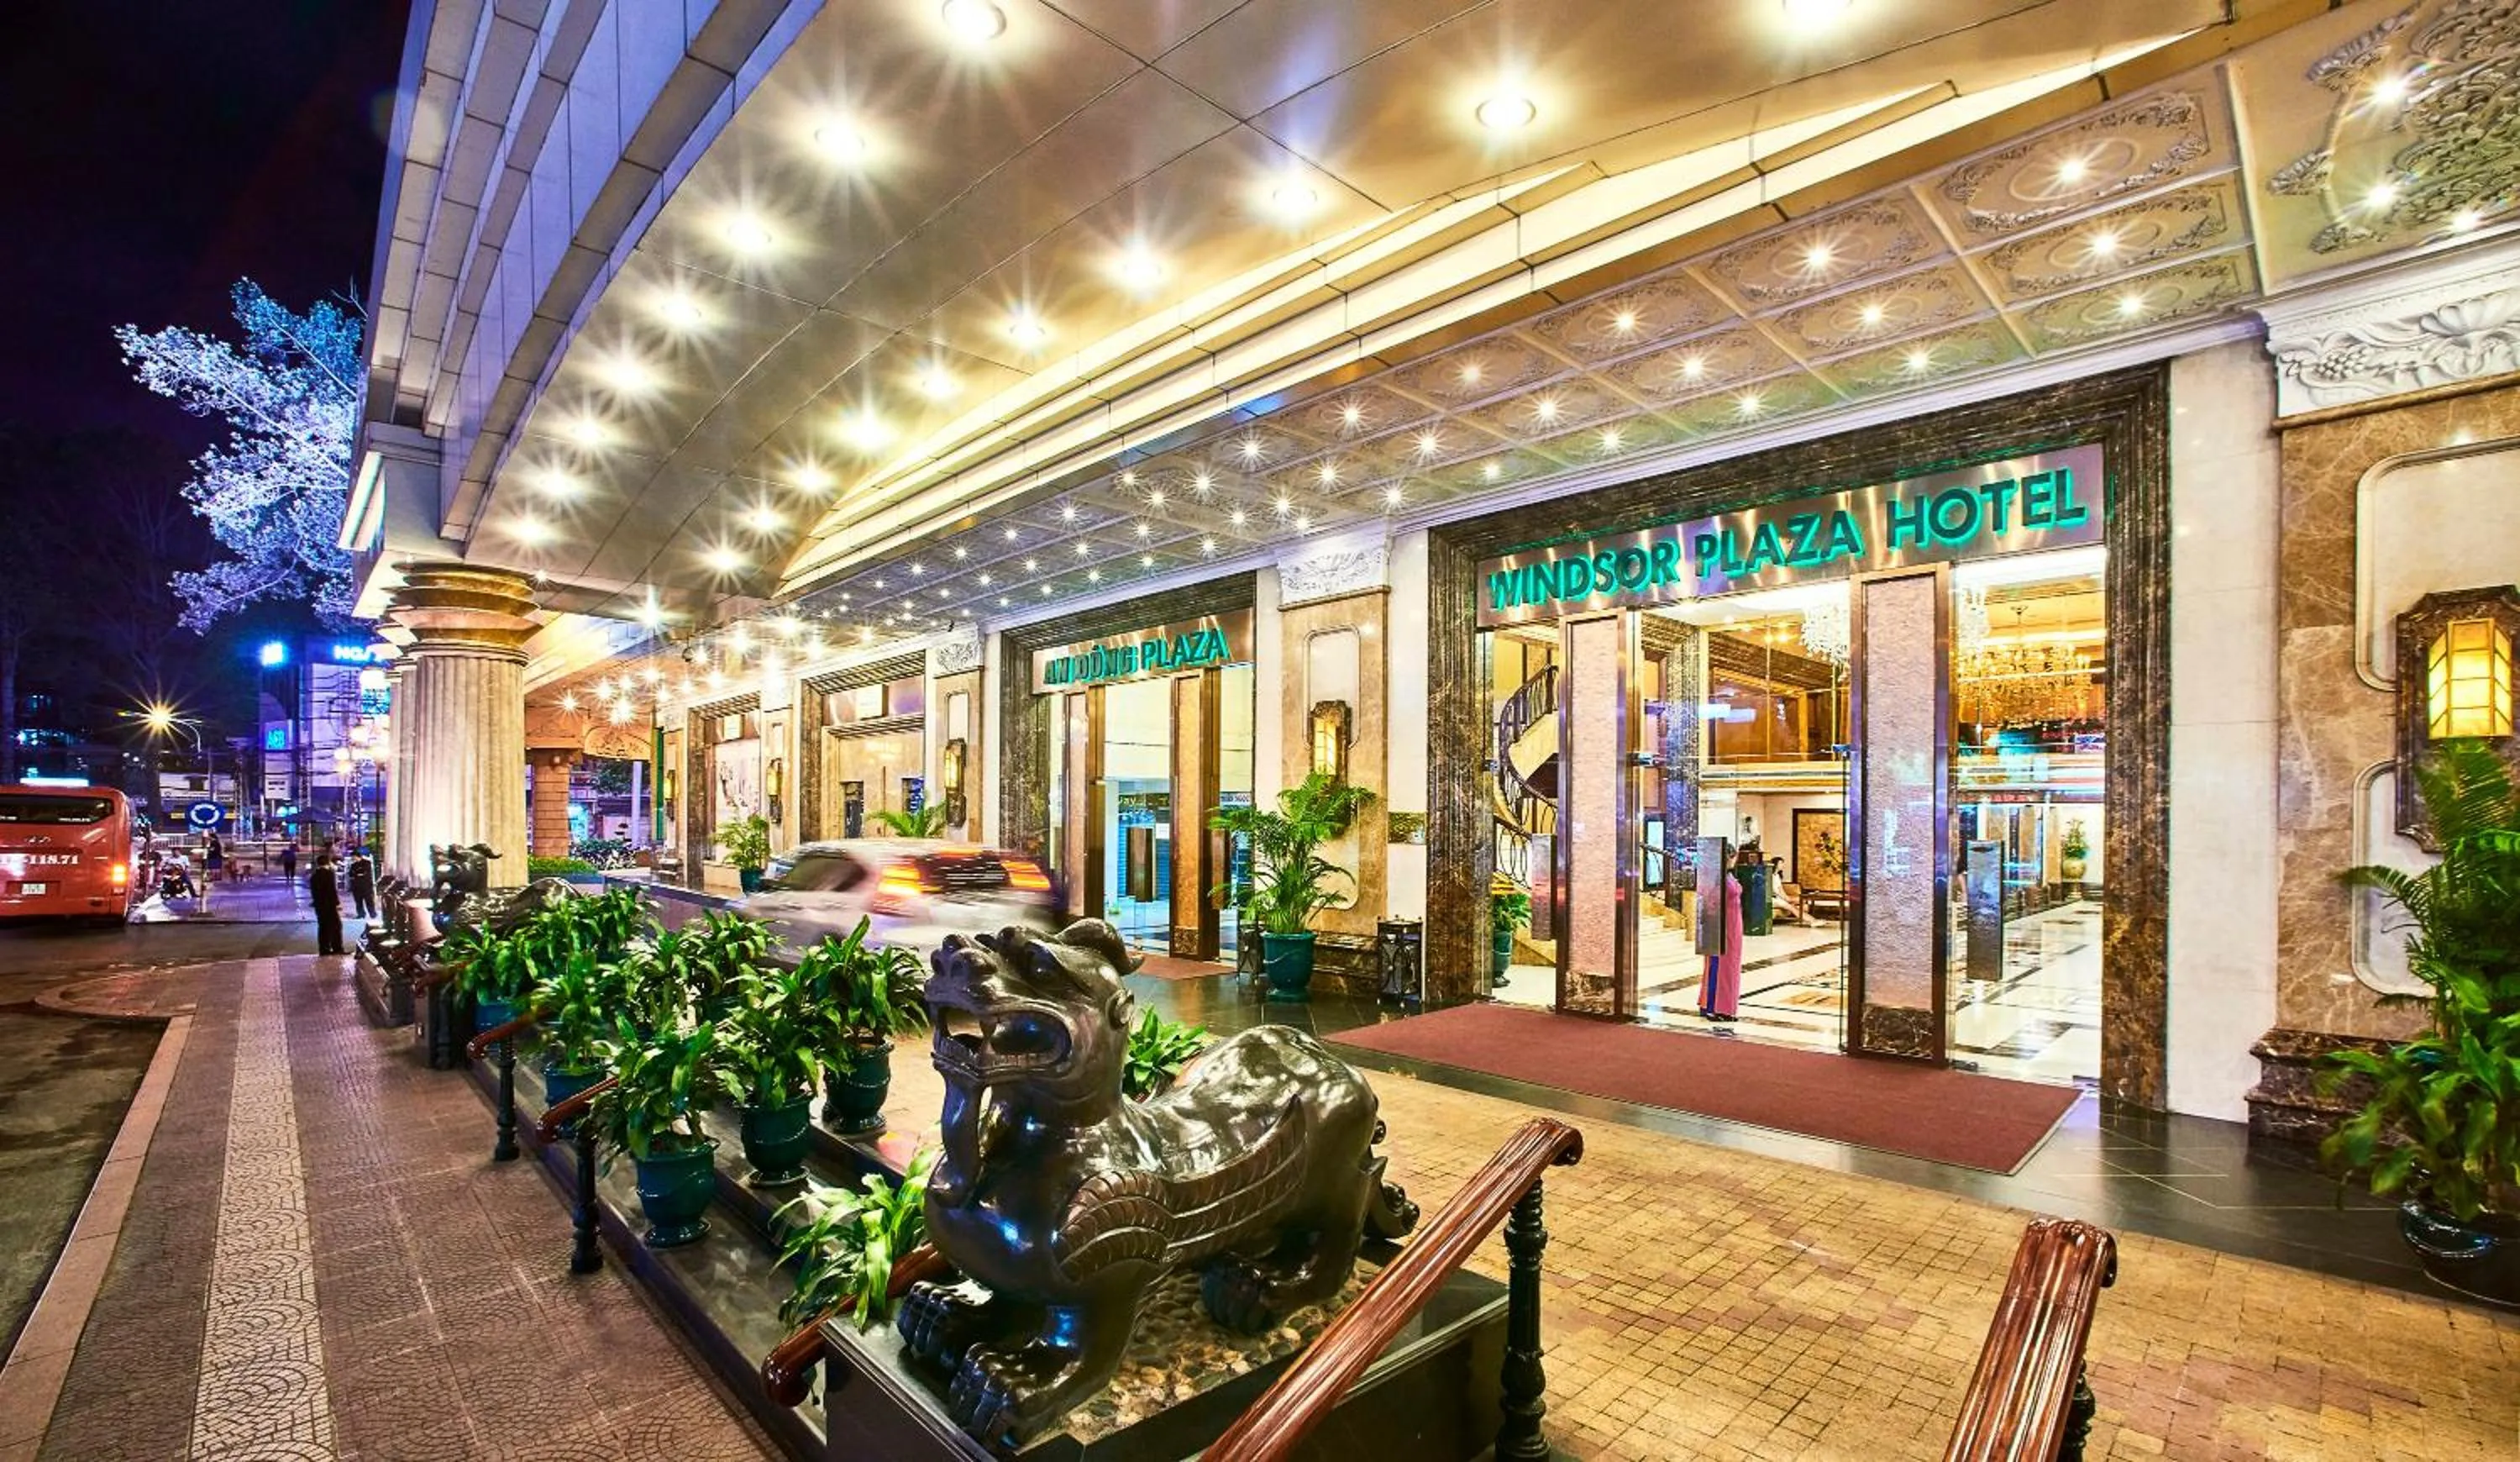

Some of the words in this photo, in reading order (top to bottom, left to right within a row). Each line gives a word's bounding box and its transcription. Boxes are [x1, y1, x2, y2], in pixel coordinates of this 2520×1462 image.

[1488, 539, 1680, 612] WINDSOR
[1694, 511, 1864, 579] PLAZA
[1885, 468, 2087, 550] HOTEL
[1044, 656, 1074, 683] AN
[1141, 626, 1230, 670] PLAZA
